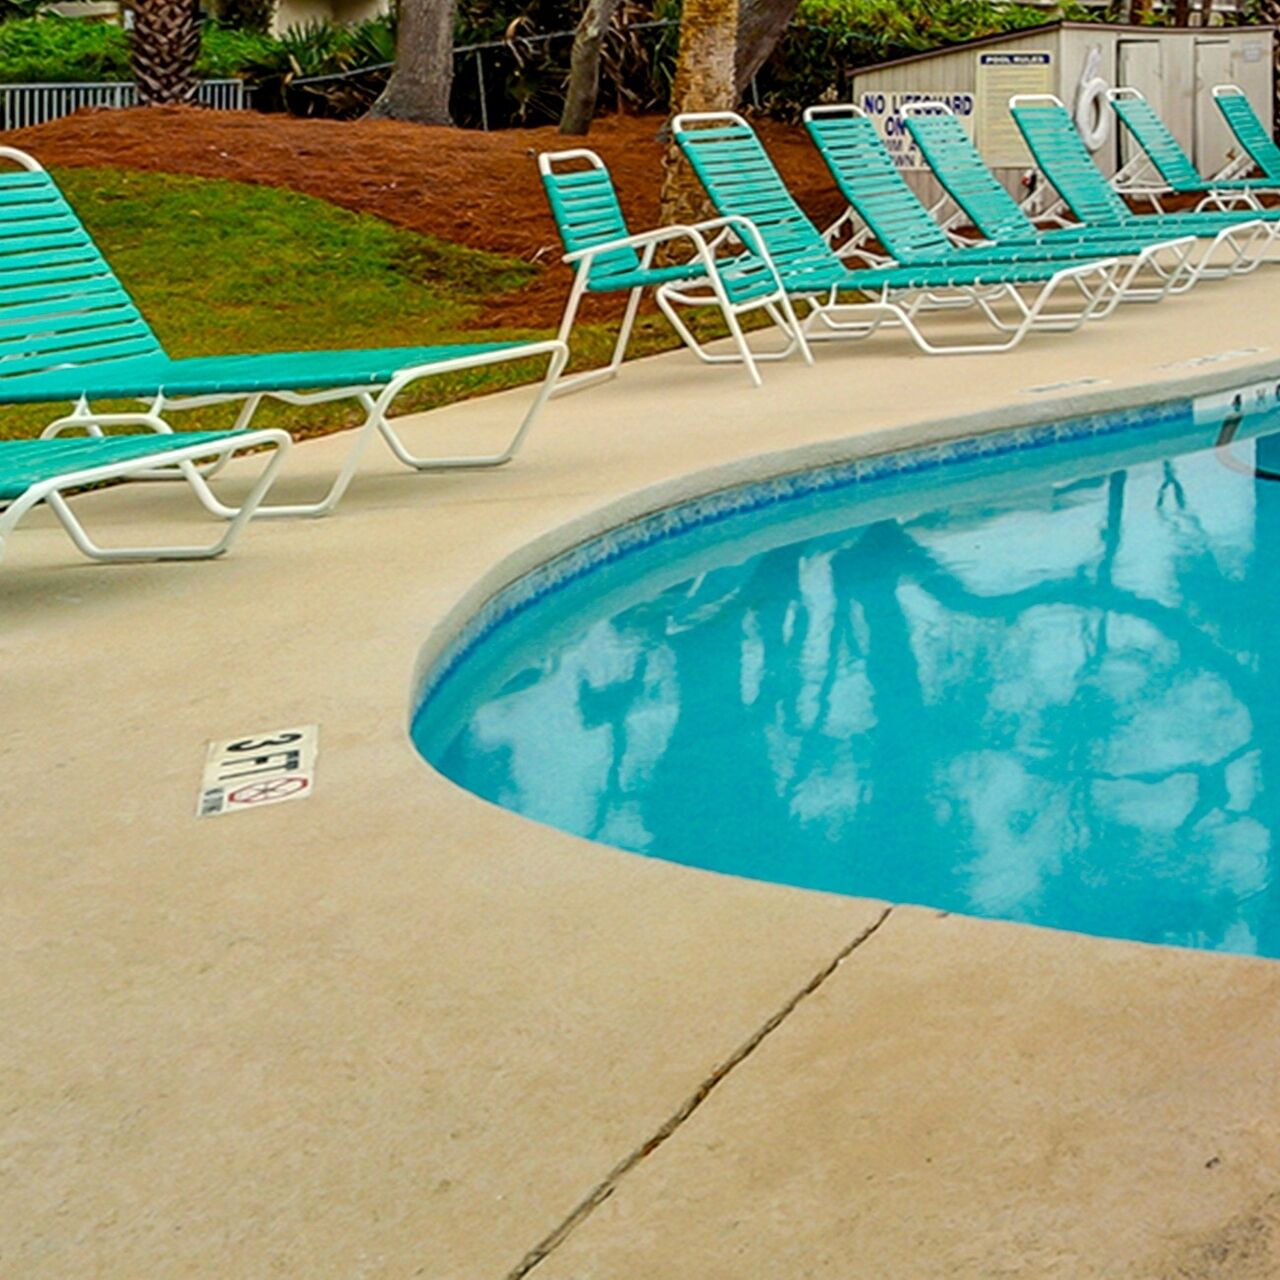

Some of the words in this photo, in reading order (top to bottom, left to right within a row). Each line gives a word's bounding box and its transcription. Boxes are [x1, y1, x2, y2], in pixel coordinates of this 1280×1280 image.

[864, 95, 885, 114] NO
[226, 733, 302, 752] 3
[218, 749, 300, 781] FT
